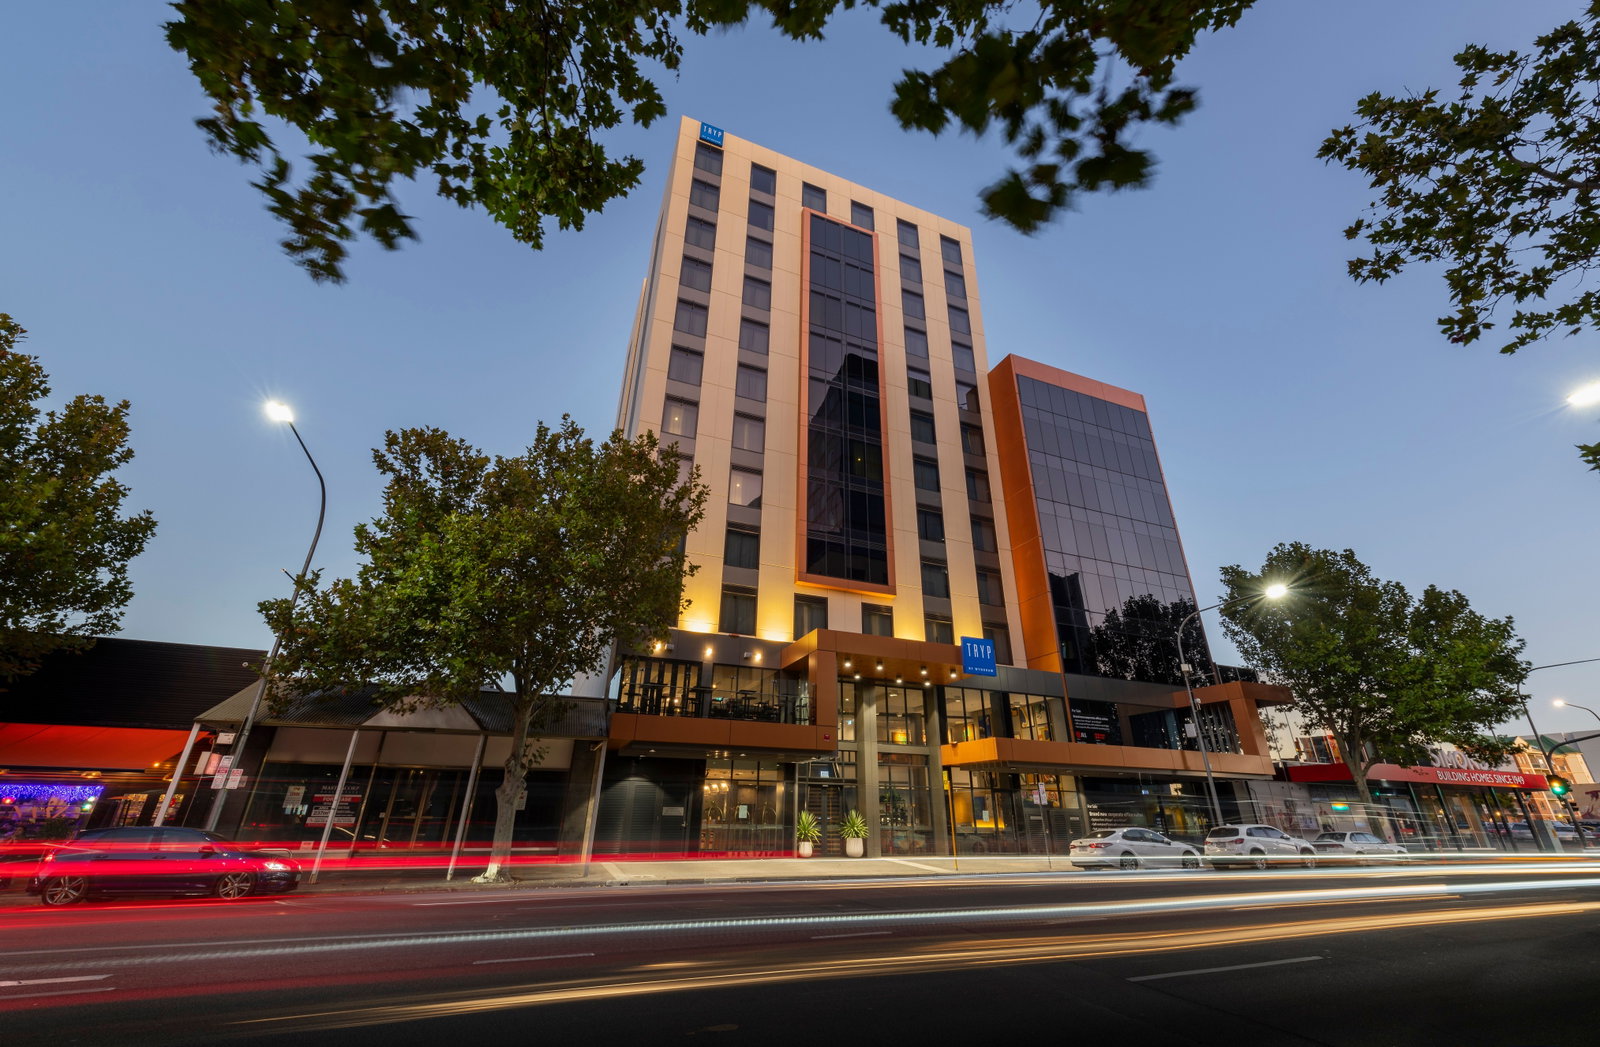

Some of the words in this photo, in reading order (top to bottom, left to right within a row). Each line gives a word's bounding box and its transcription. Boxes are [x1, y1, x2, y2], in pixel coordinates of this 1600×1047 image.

[703, 125, 722, 138] TRYP
[966, 642, 992, 660] TRYP
[1436, 770, 1471, 782] BUILDING
[1470, 773, 1494, 783] HOMES
[1494, 774, 1513, 784] SINCE
[1511, 776, 1525, 785] 1949
